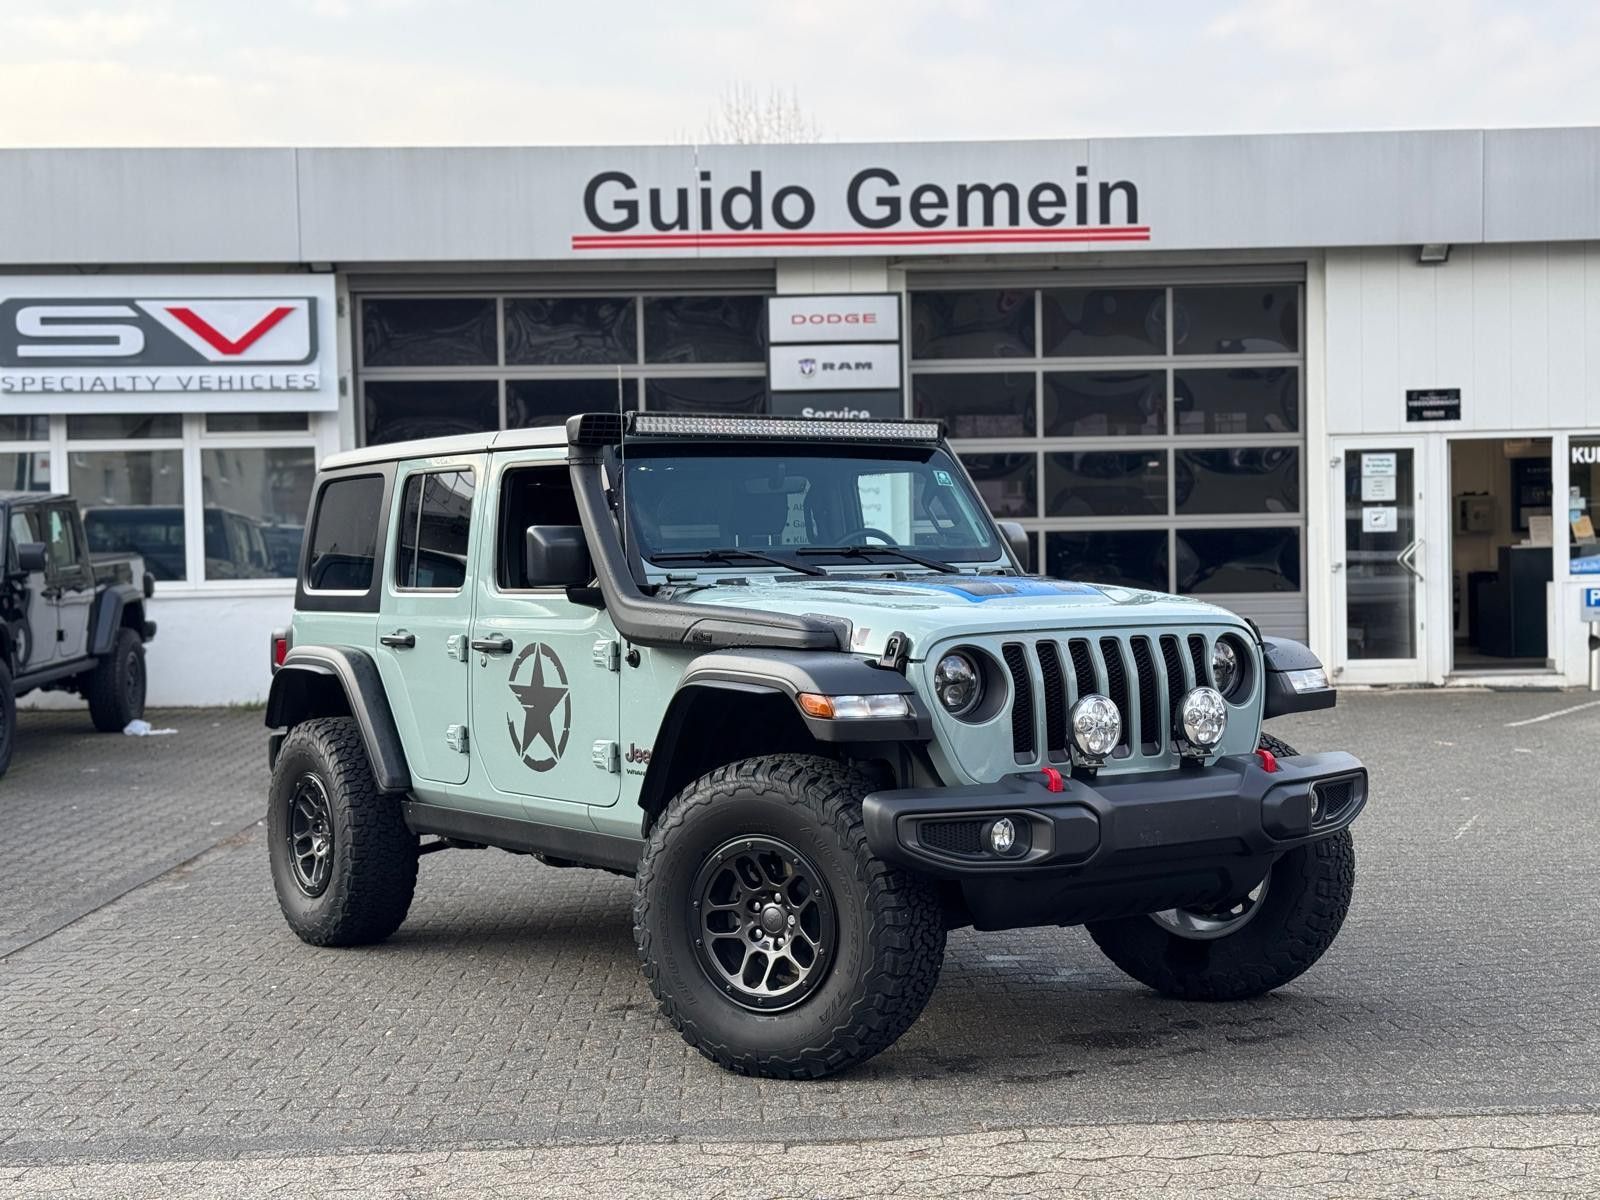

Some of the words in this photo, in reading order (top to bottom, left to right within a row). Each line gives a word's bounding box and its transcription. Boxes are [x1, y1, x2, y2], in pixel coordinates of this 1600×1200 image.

[583, 170, 816, 233] Guido
[846, 166, 1139, 230] Gemein
[791, 313, 877, 325] DODGE
[15, 305, 298, 358] SV
[822, 362, 873, 371] RAM
[1, 375, 162, 392] SPECIALTY
[176, 374, 318, 390] VEHICLES
[801, 407, 871, 418] Service
[625, 742, 652, 764] Jee
